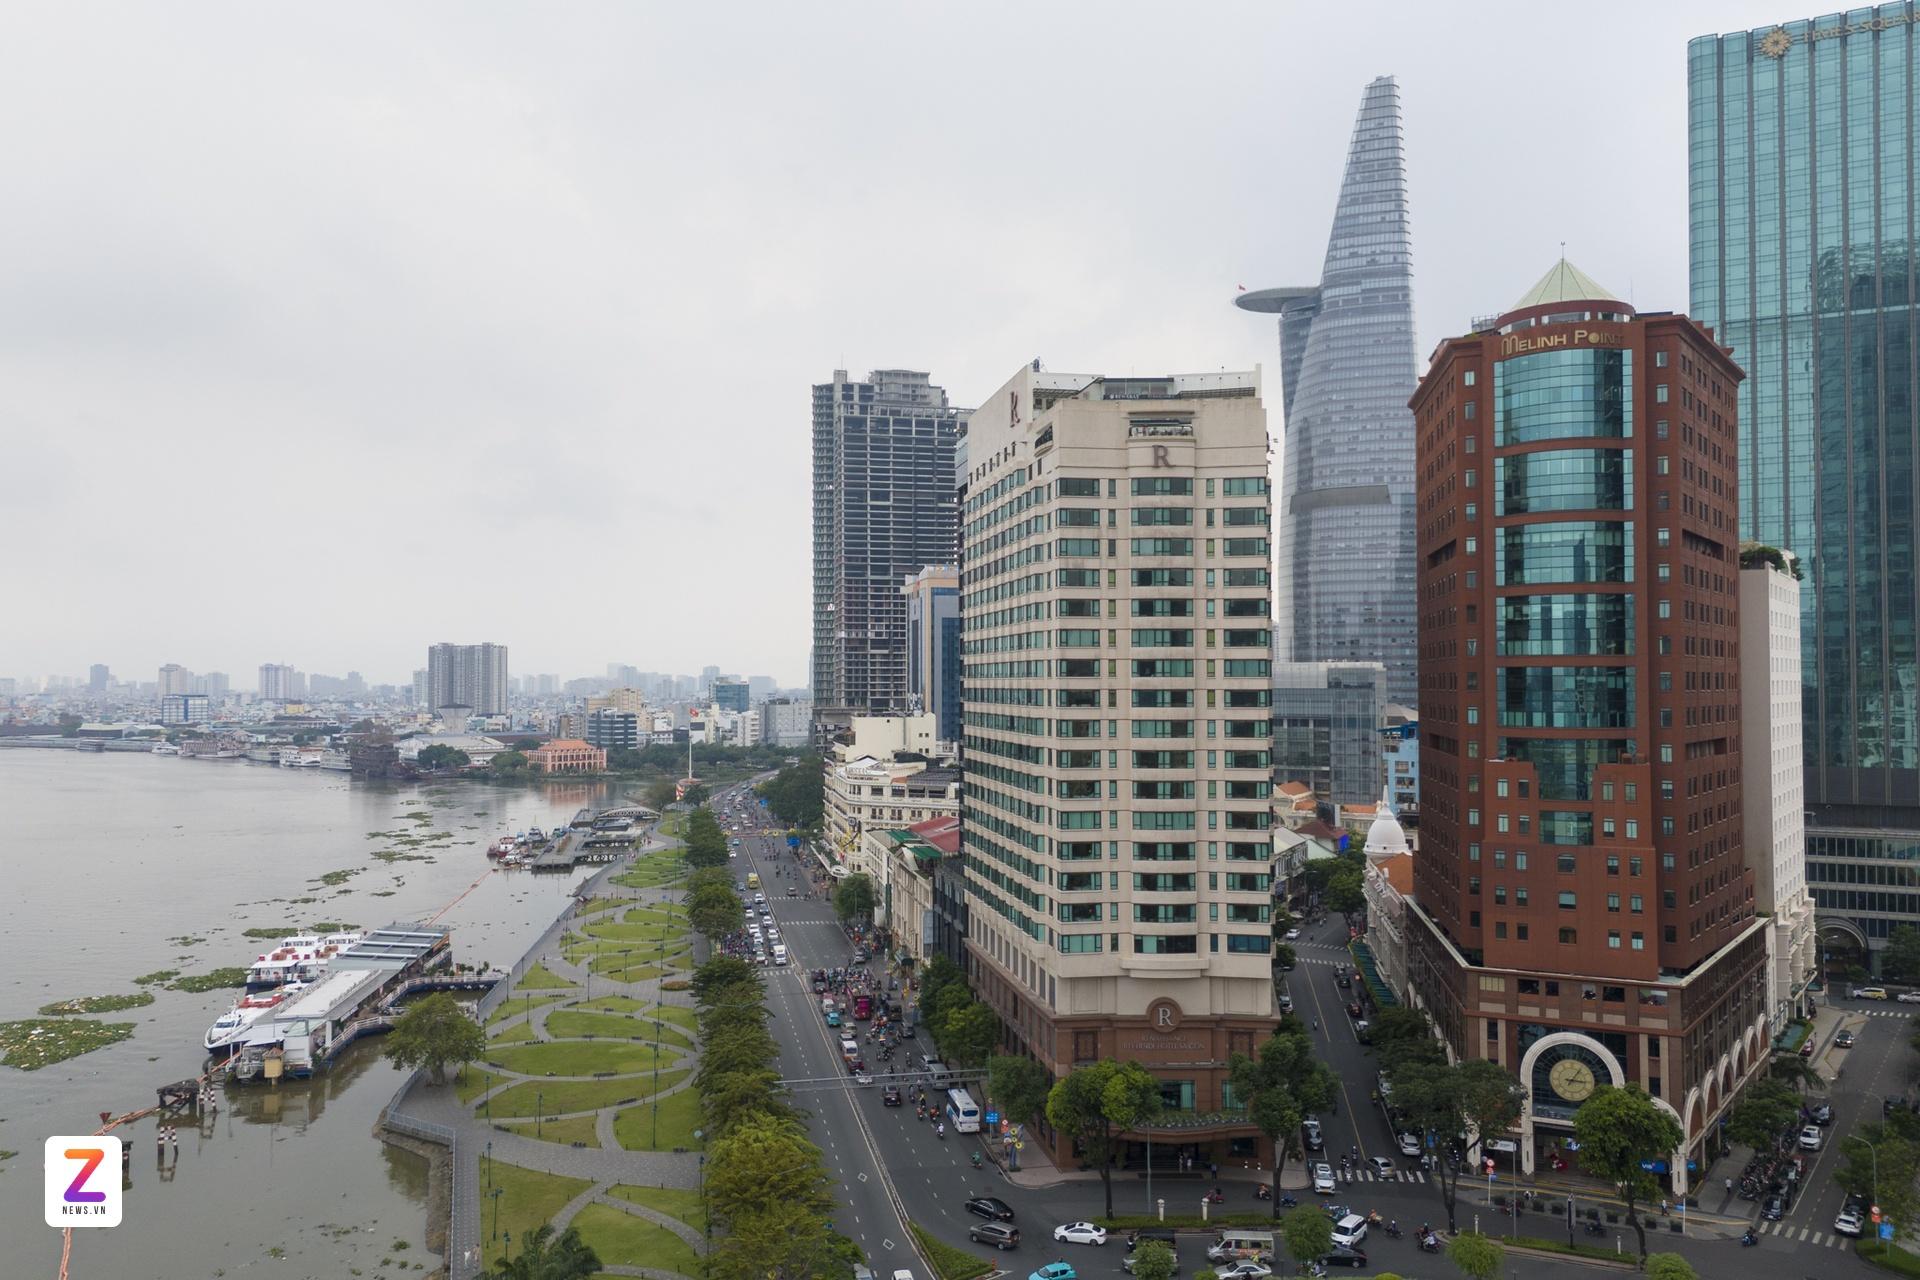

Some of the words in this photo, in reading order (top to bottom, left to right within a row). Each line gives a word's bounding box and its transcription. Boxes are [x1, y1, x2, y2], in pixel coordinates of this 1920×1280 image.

[1501, 333, 1567, 356] MELINH
[1151, 444, 1177, 468] R
[1157, 1007, 1174, 1026] R
